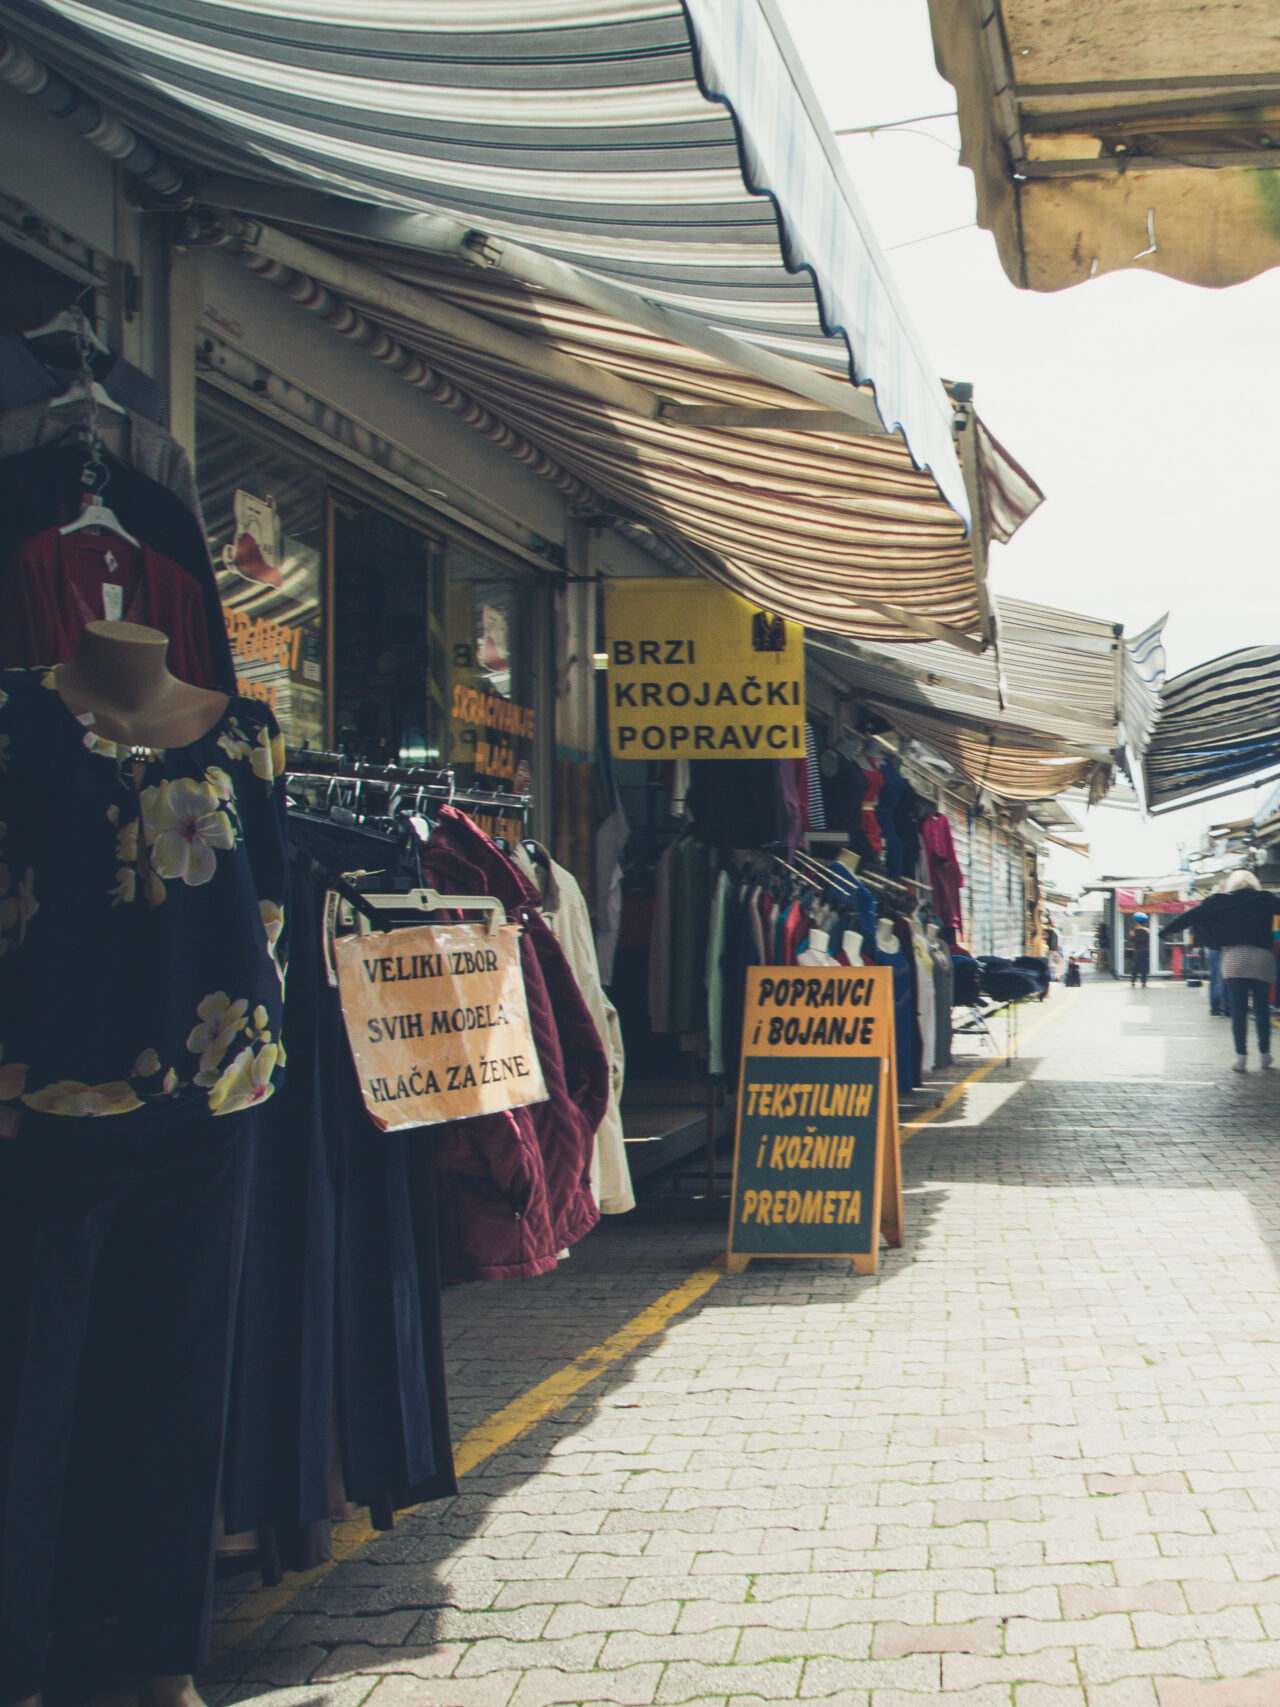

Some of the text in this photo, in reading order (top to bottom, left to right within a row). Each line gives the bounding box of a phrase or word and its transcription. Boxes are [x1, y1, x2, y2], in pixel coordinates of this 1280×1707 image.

[613, 639, 695, 665] BRZI
[614, 675, 800, 707] KROJAČKI
[617, 724, 800, 750] POPRAVCI
[362, 949, 499, 983] VELIKI IZBOR
[757, 977, 874, 1008] POPRAVCI
[367, 1003, 510, 1044] SVIH MODELA
[752, 1016, 875, 1046] i BOJANJE
[368, 1054, 531, 1104] HLAČA ZA ŽENE
[746, 1083, 874, 1119] TEKSTILNIH
[756, 1125, 856, 1171] i KOŽNIH
[741, 1188, 862, 1227] PREDMETA
